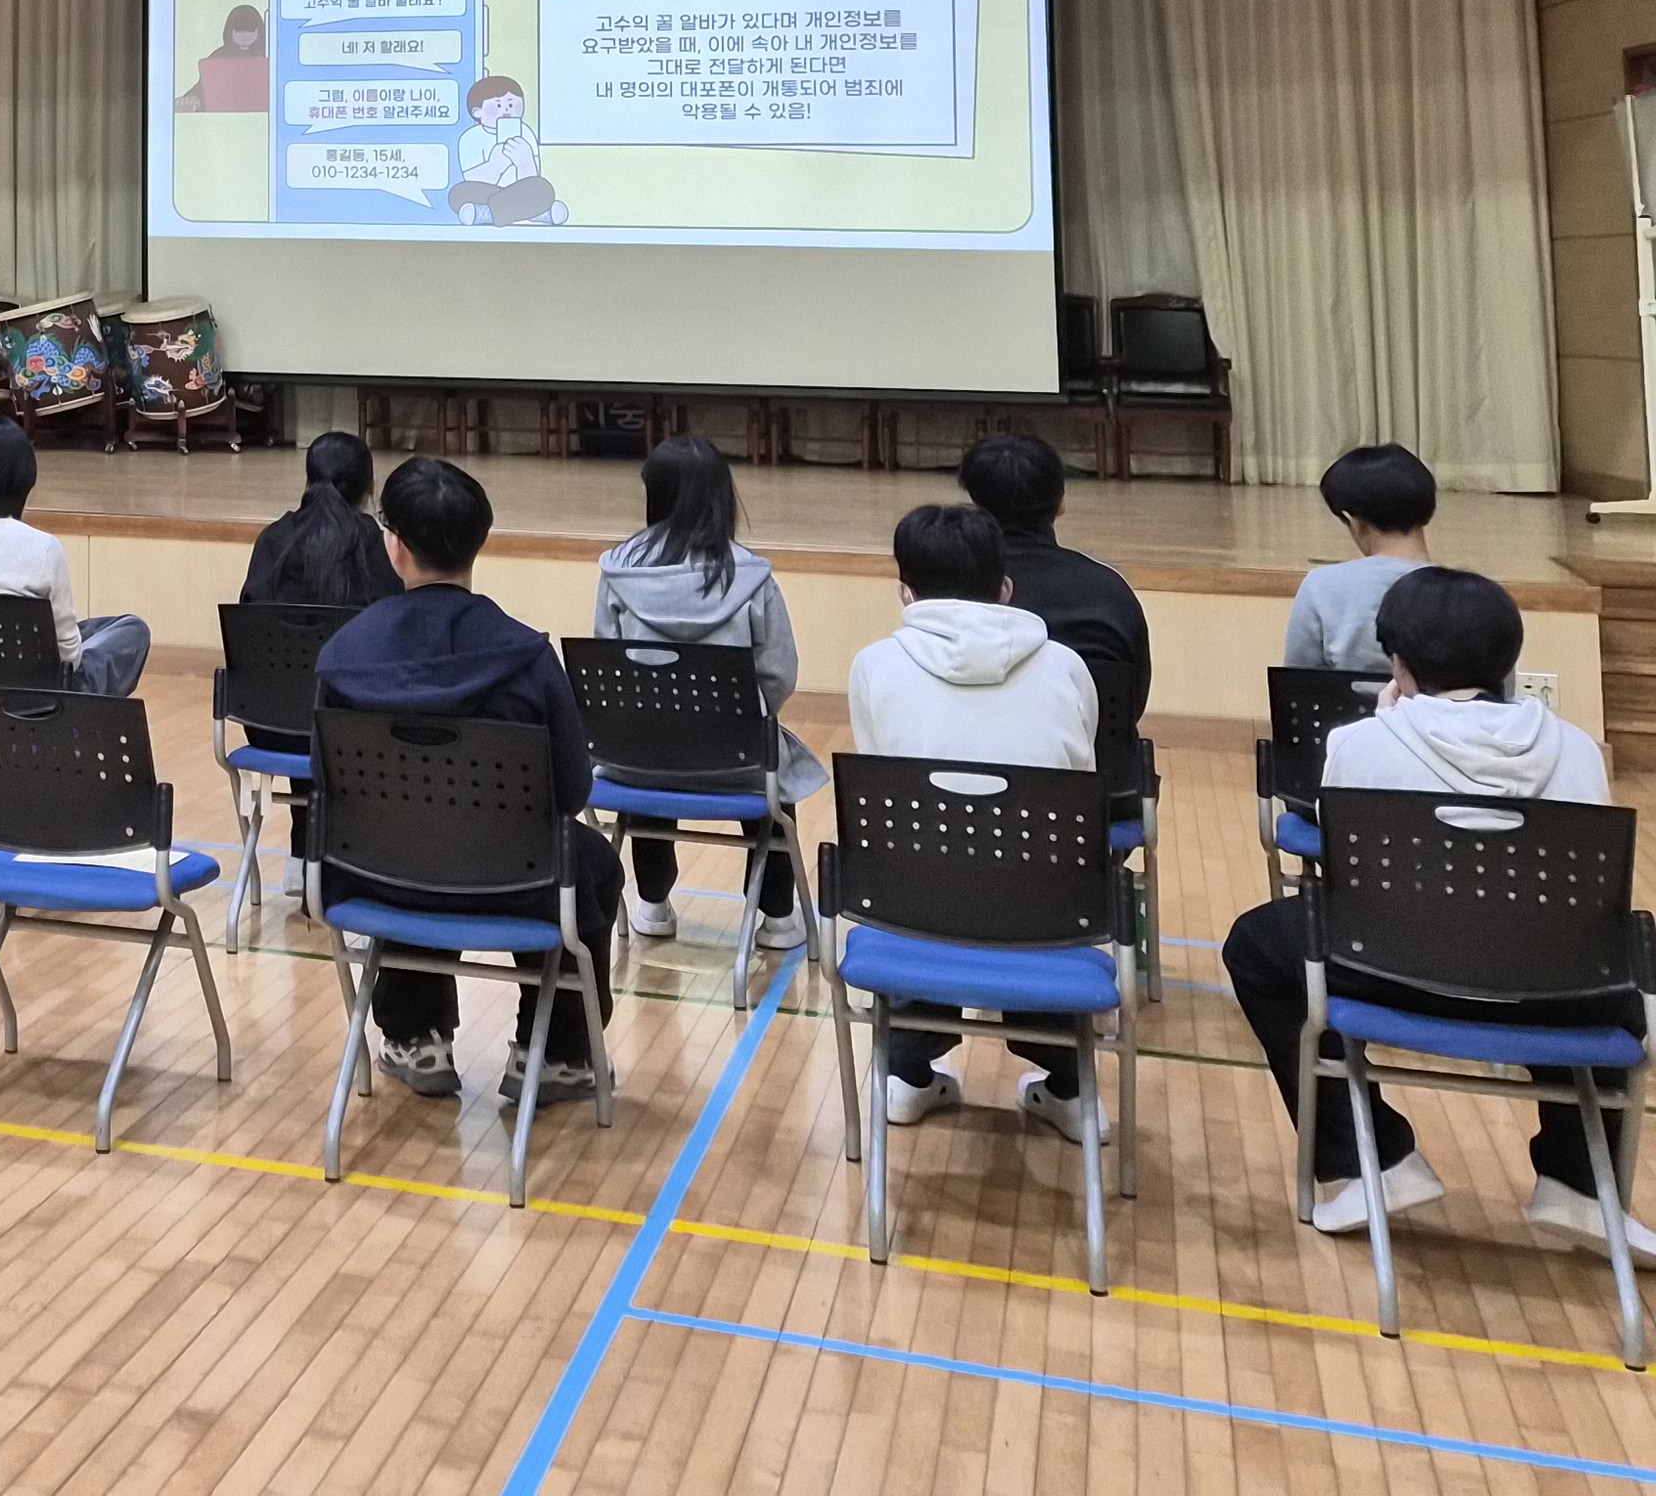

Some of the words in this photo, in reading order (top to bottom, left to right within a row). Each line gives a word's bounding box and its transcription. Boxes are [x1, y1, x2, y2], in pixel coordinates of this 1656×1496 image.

[595, 15, 649, 32] 고수익
[656, 14, 673, 32] 꿀
[679, 13, 736, 31] 알바가
[742, 12, 797, 30] 있다며
[805, 9, 901, 28] 개인정보를
[341, 41, 359, 54] 네!
[362, 40, 375, 54] 저
[380, 39, 424, 54] 할래요!
[582, 36, 672, 55] 요구받았을
[678, 36, 701, 54] 때,
[708, 35, 744, 53] 이에
[751, 34, 789, 52] 속아
[795, 33, 813, 51] 내
[820, 32, 917, 51] 개인정보를
[647, 58, 702, 76] 그대로
[709, 57, 783, 75] 전달하게
[790, 56, 846, 74] 된다면
[319, 89, 348, 104] 그럼,
[410, 88, 440, 102] 나이,
[596, 81, 613, 98] 내
[619, 80, 673, 99] 명의의
[680, 80, 754, 98] 대포폰이
[762, 79, 837, 98] 개통되어
[844, 78, 903, 97] 범죄에
[309, 105, 347, 120] 휴대폰
[352, 106, 378, 119] 번호
[383, 105, 450, 119] 알려주세요
[682, 103, 737, 120] 악용될
[744, 103, 761, 120] 수
[768, 102, 811, 120] 있음!
[374, 149, 406, 163] 15세,
[311, 165, 419, 180] 010-1234-1234
